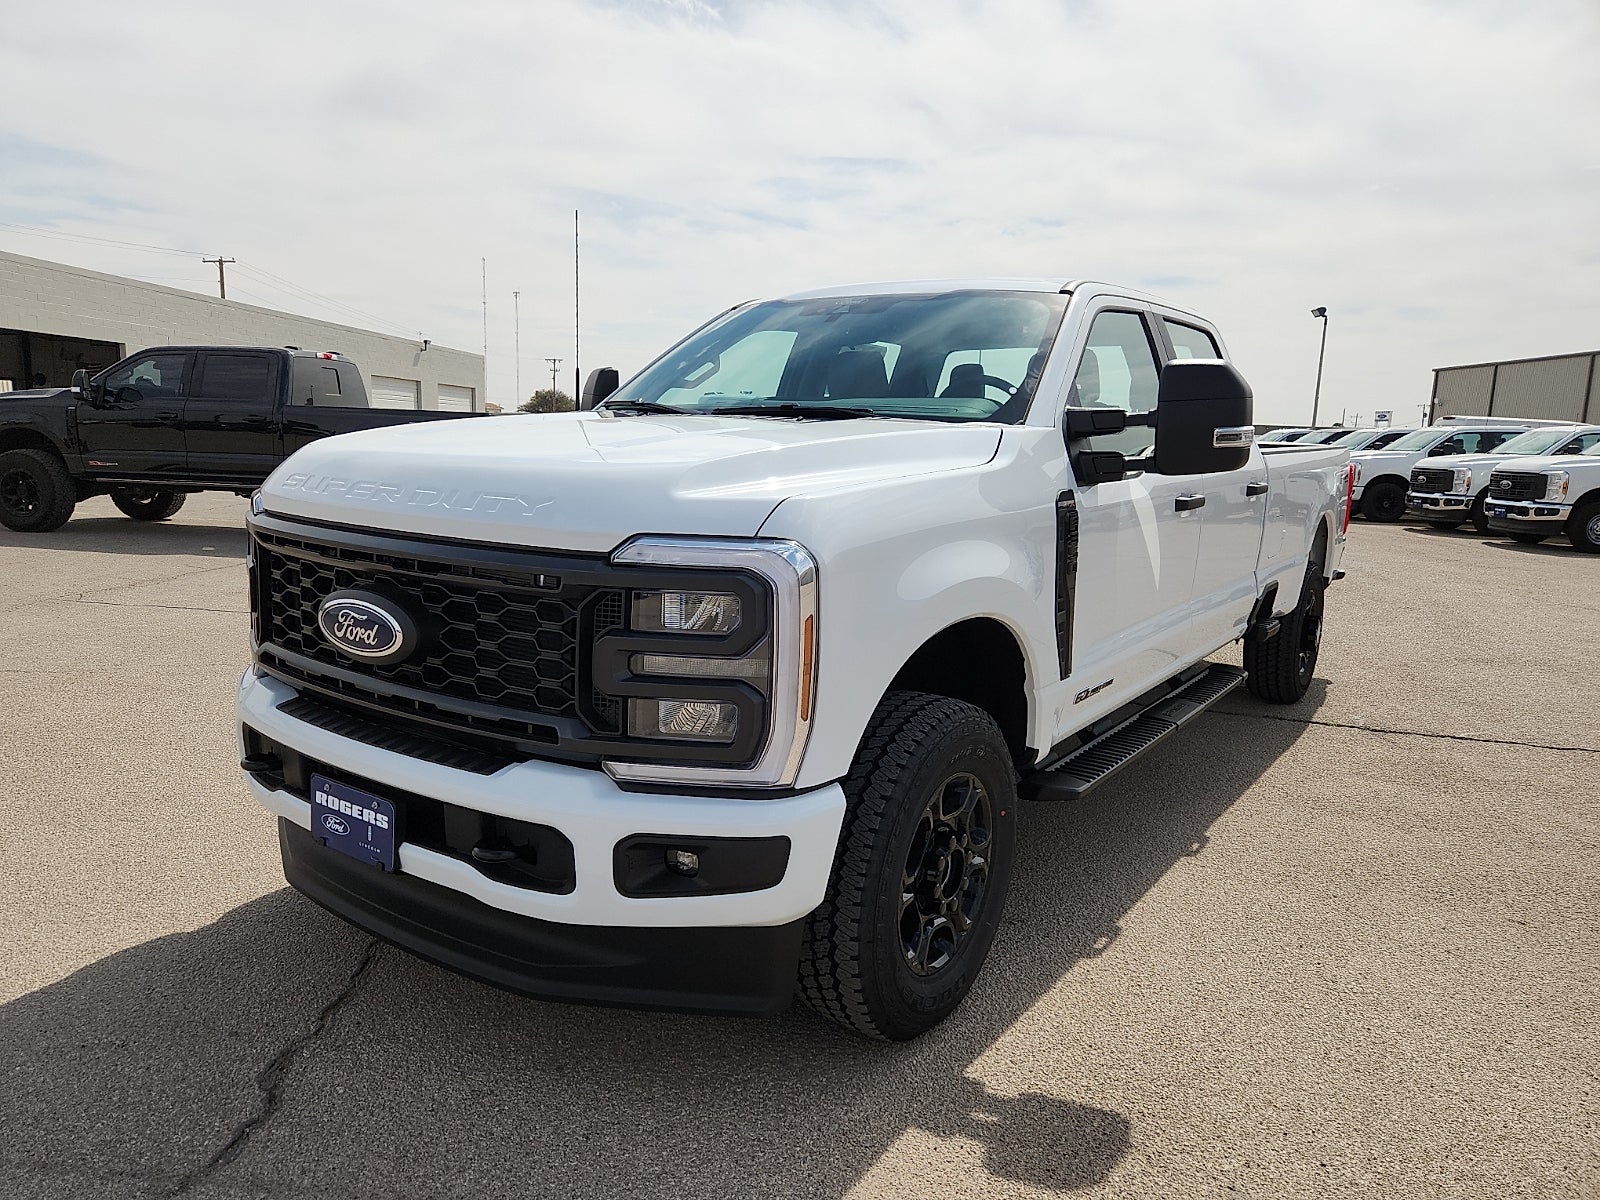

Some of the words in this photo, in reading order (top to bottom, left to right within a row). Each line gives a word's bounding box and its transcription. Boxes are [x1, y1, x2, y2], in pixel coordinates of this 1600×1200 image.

[281, 472, 402, 504] SUPER
[407, 487, 556, 516] DUTY
[334, 609, 379, 646] Ford
[315, 790, 389, 830] ROGERS
[326, 816, 345, 833] Ford
